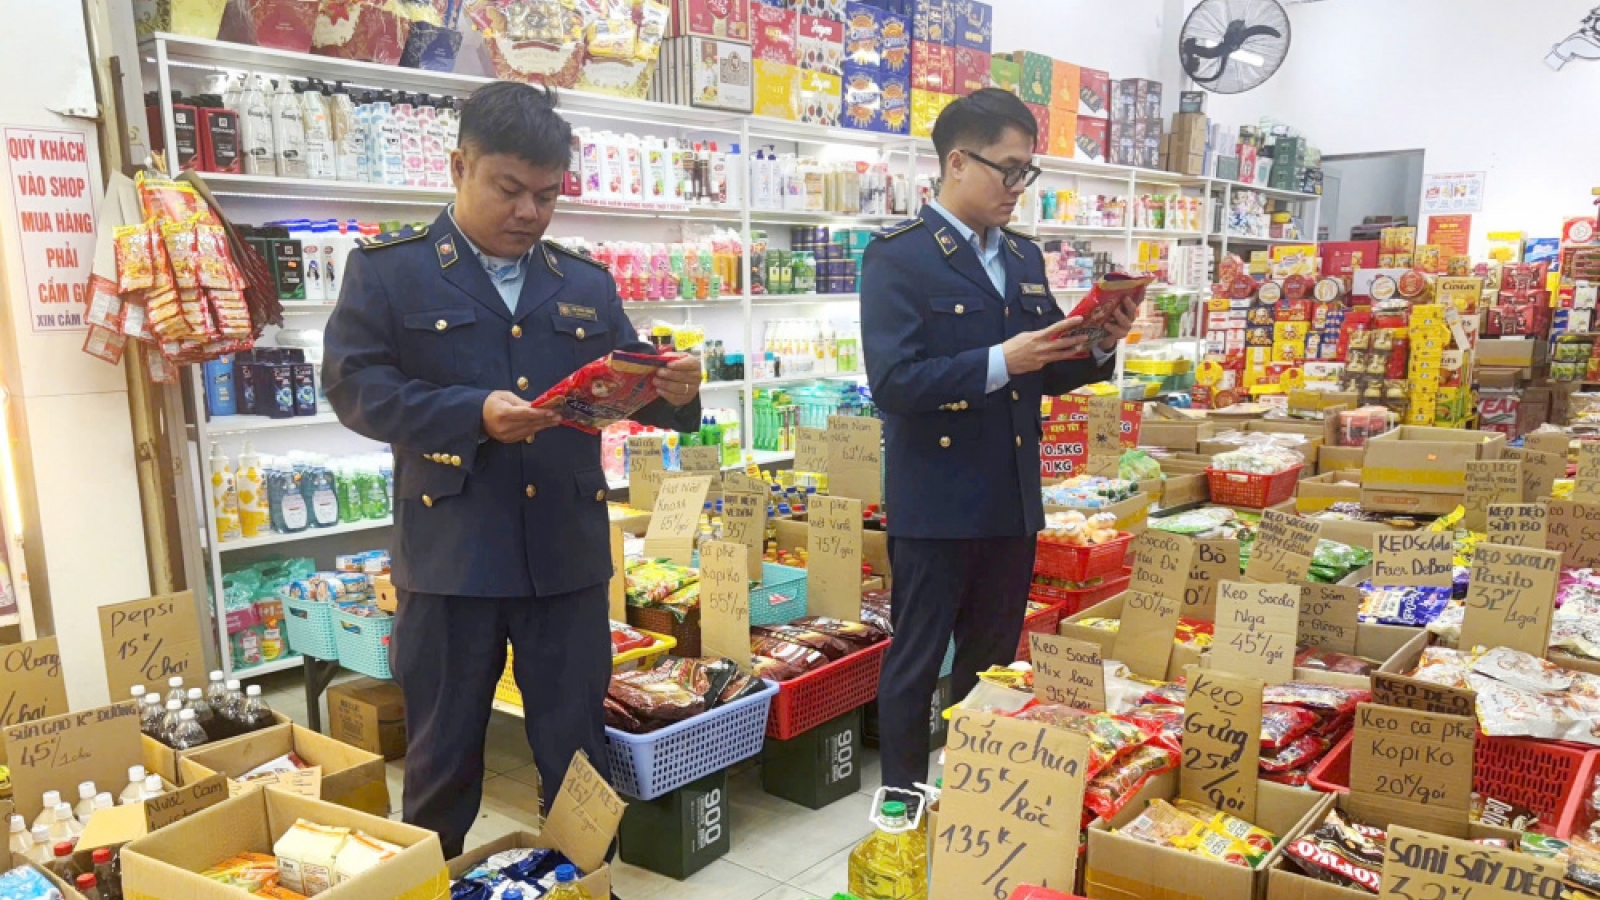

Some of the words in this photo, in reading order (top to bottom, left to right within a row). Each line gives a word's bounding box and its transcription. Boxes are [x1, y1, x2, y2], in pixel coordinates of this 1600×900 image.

[8, 134, 36, 160] QUÝ
[40, 132, 86, 162] KHÁCH
[18, 171, 47, 196] VÀO
[50, 176, 85, 198] SHOP
[21, 211, 53, 233] MUA
[56, 209, 93, 234] HÀNG
[46, 241, 79, 268] PHẢI
[73, 282, 89, 304] GI
[36, 314, 56, 327] XIN
[1045, 444, 1082, 456] 0.5KG
[1199, 543, 1227, 564] Bò
[1188, 564, 1210, 580] úc
[1233, 608, 1265, 631] Nga
[1036, 660, 1061, 678] Mix
[1189, 673, 1244, 710] Kẹo
[1361, 709, 1399, 734] Kẹo
[838, 729, 852, 779] 900
[705, 788, 721, 844] 900
